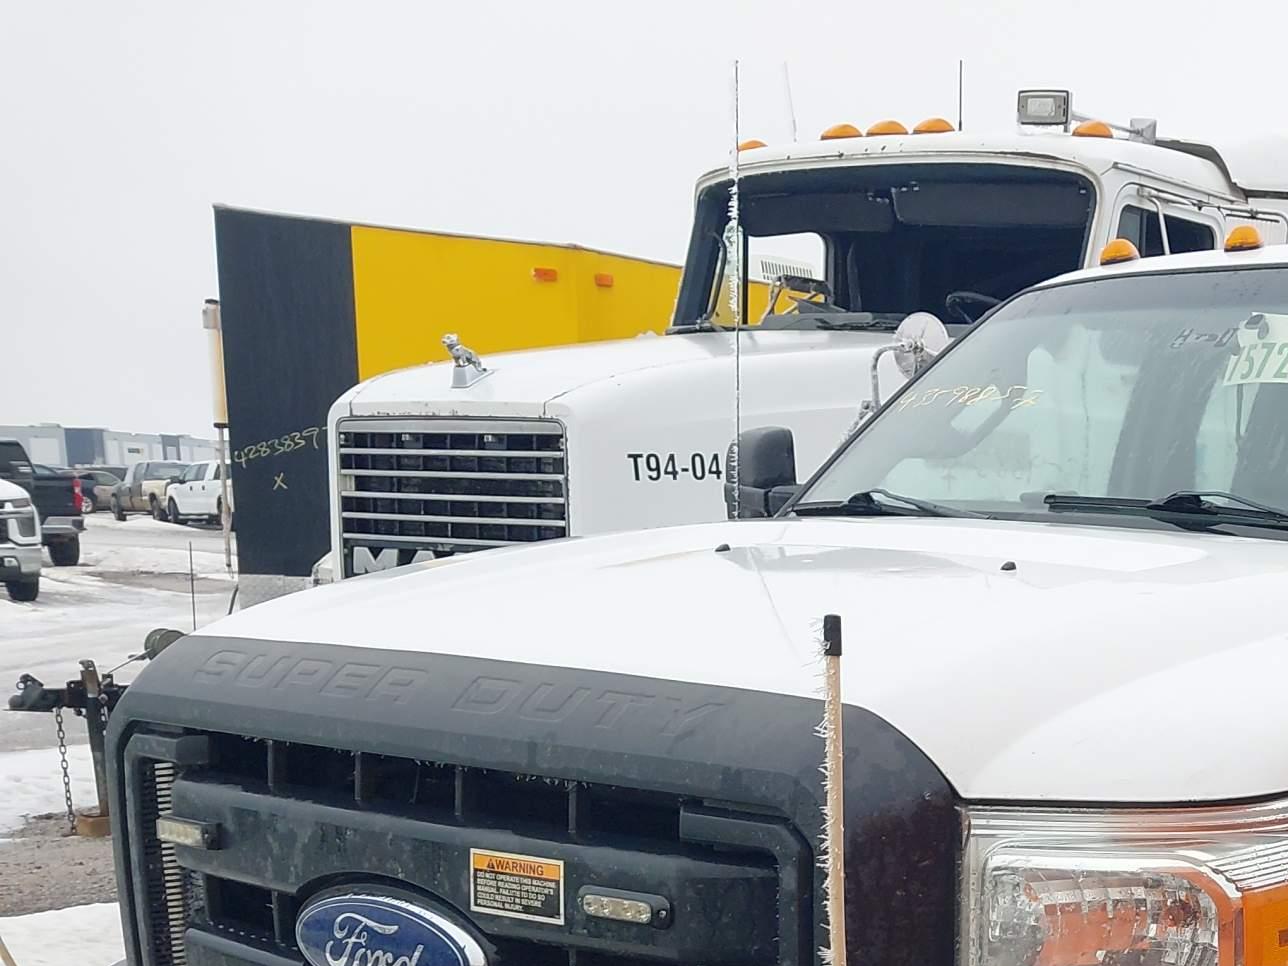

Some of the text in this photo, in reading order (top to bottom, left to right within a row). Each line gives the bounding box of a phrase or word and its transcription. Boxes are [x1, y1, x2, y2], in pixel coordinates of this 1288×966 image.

[627, 452, 722, 481] T94-04
[192, 649, 726, 741] SUPER DUTY
[495, 859, 544, 876] WARNING
